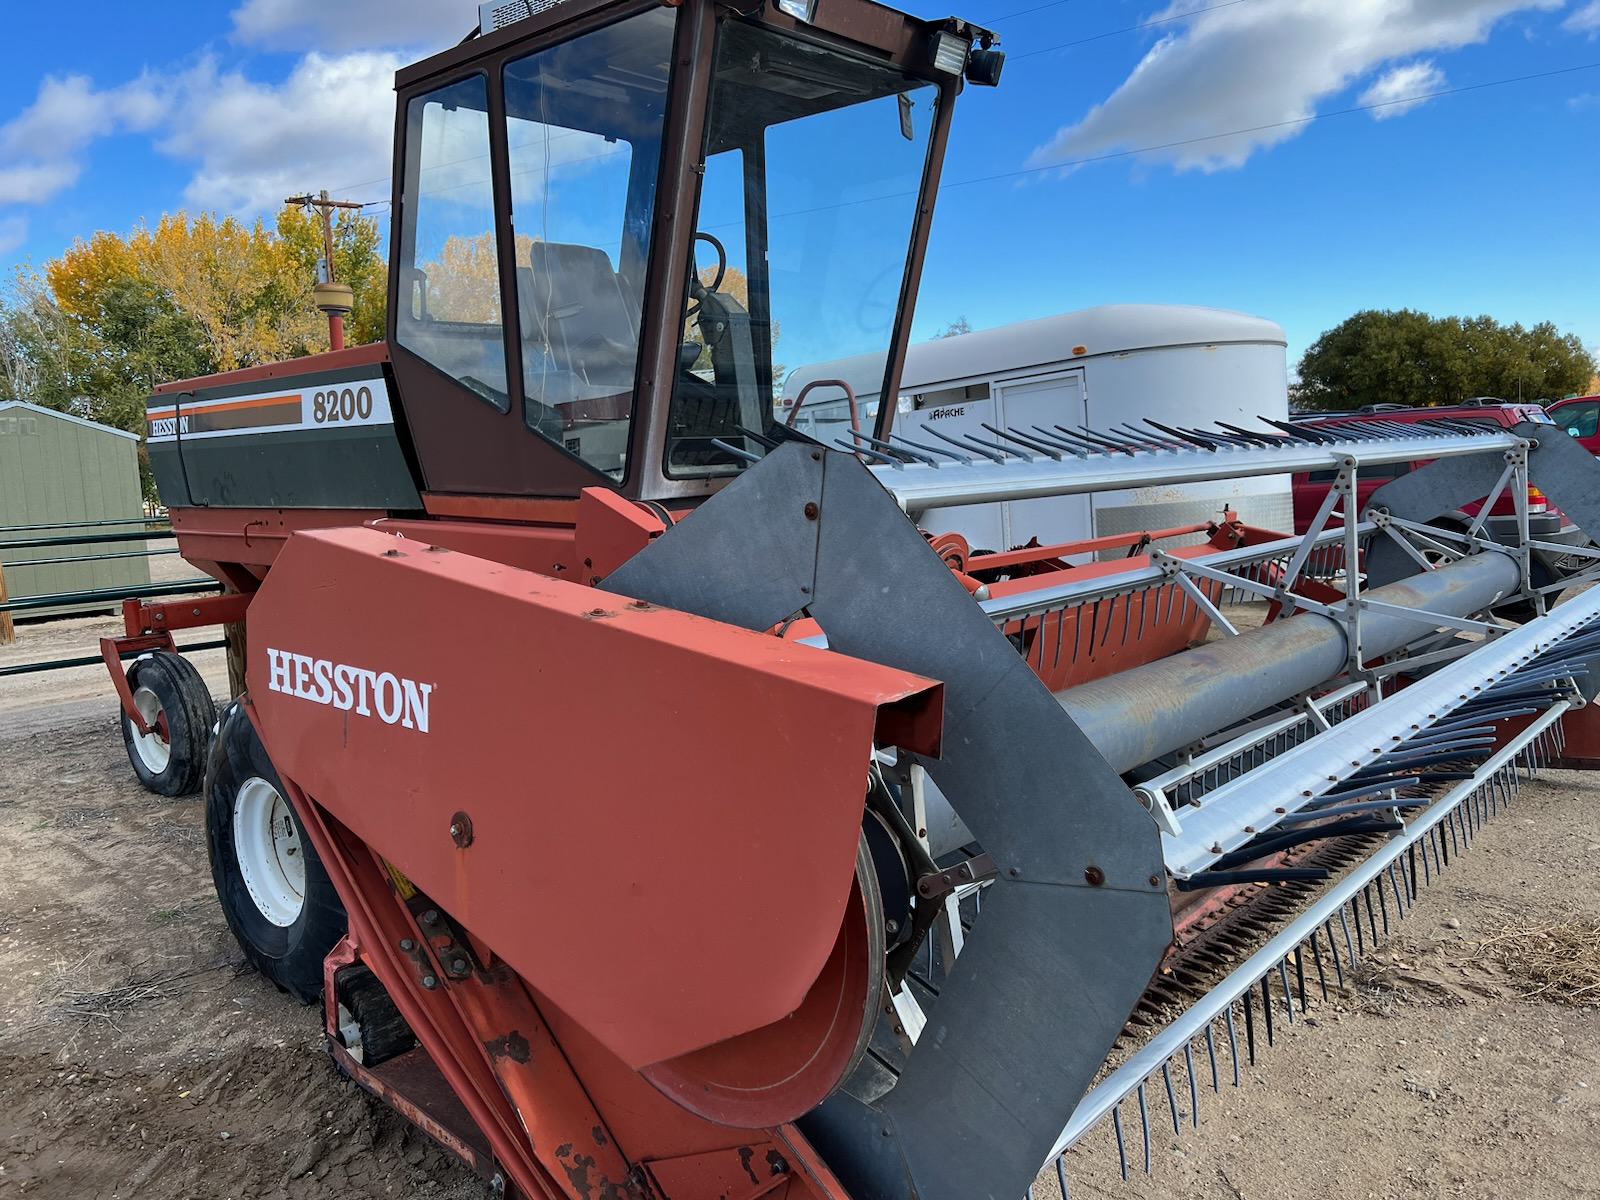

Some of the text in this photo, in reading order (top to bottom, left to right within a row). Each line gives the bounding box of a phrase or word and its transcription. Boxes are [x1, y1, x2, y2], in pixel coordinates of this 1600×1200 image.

[313, 386, 373, 423] 8200
[933, 407, 965, 421] APACHE
[152, 416, 188, 436] HESSTN
[267, 647, 433, 733] HESSTON
